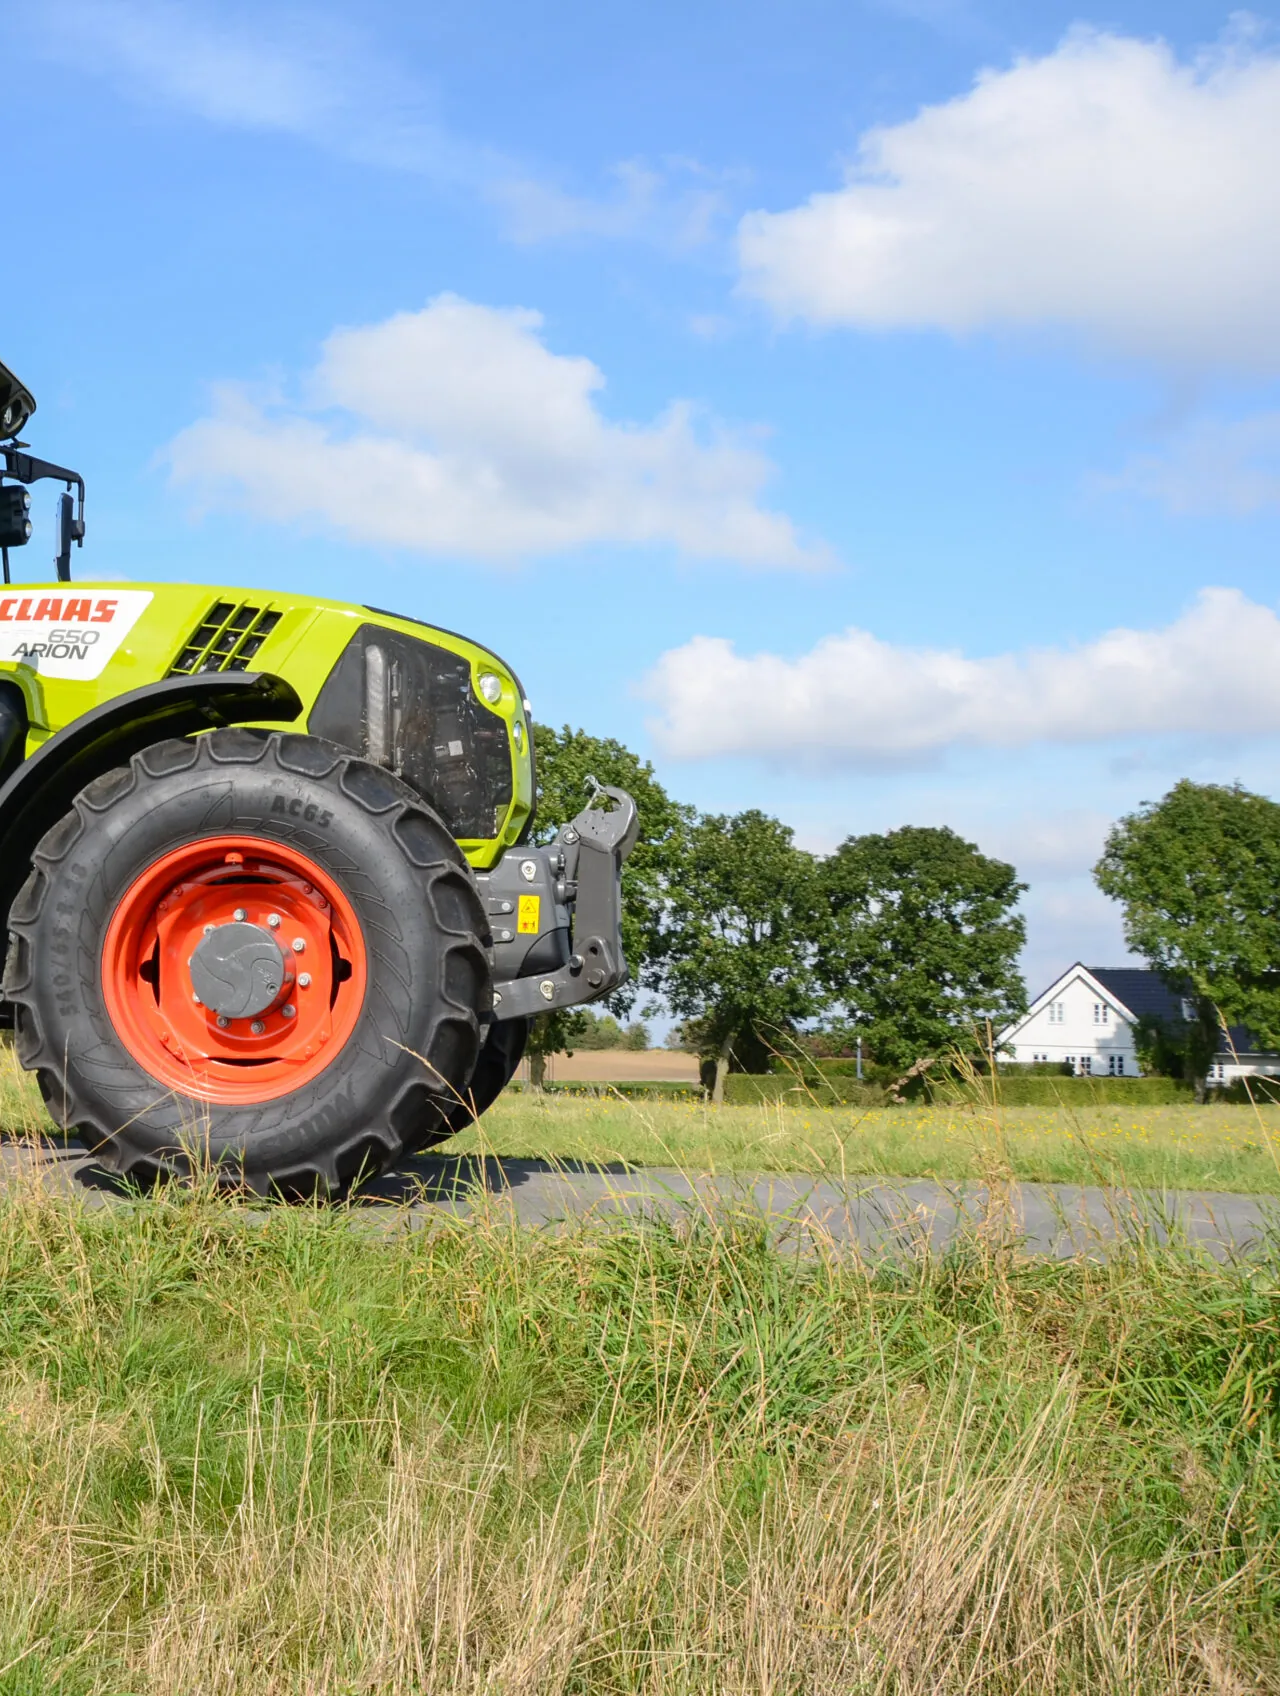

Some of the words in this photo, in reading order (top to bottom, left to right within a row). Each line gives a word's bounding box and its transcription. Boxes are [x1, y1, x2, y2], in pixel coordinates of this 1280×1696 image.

[48, 628, 100, 645] 650
[11, 642, 89, 660] ARION
[270, 795, 335, 828] AC65
